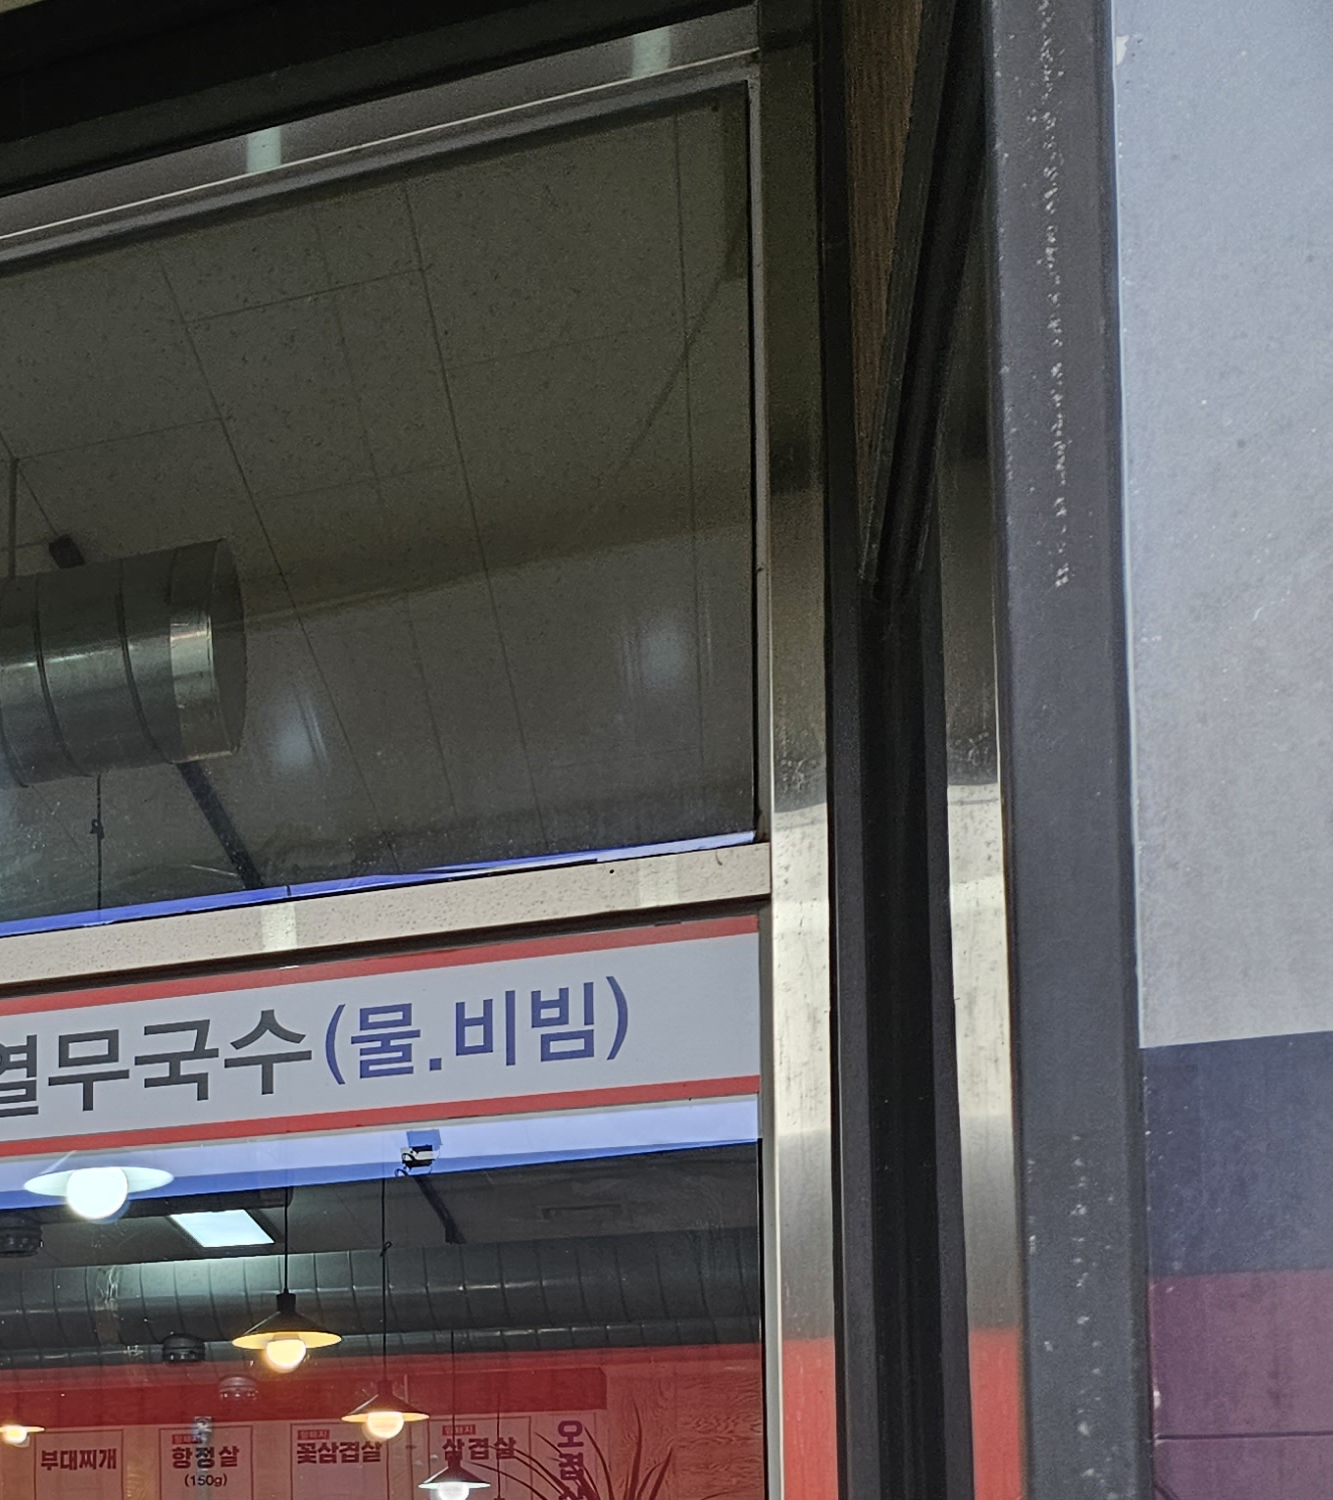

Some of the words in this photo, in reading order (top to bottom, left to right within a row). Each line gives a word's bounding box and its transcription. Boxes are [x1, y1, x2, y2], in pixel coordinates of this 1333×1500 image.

[40, 1446, 118, 1471] 부대찌개
[171, 1445, 240, 1469] 항정살
[297, 1440, 383, 1464] 꽃삼겹살
[442, 1436, 517, 1461] 삼겹살
[184, 1473, 228, 1488] (150g)
